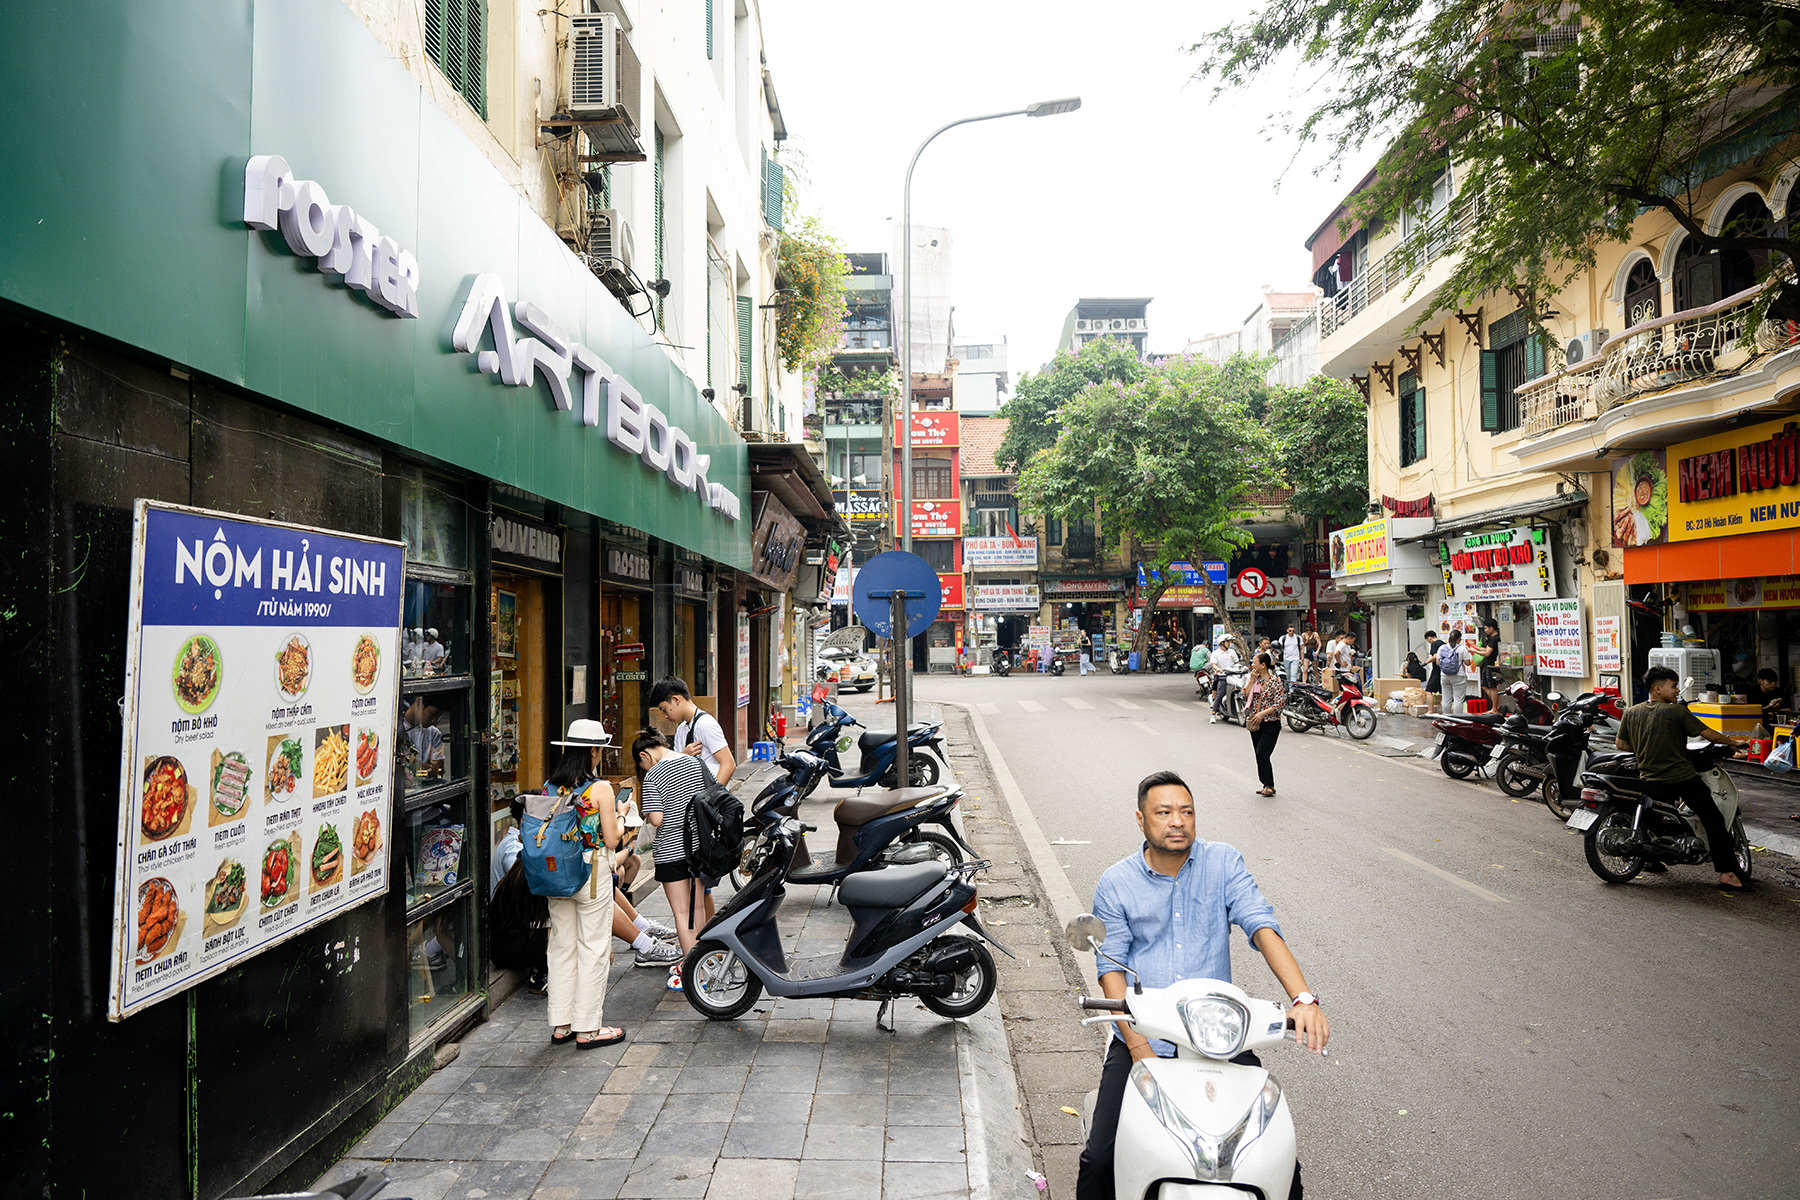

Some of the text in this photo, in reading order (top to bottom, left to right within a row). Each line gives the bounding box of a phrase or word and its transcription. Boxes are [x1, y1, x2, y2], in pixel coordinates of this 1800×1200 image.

[244, 155, 419, 319] POSTER
[453, 272, 711, 503] ARTBOOK
[1679, 422, 1800, 502] NEM NƯỚ
[1686, 514, 1742, 530] ĐC: 23 Hồ Hoàn Kiếm
[1750, 504, 1776, 522] NEM
[490, 516, 560, 563] OUVENIR
[966, 538, 1014, 549] PHỞ GÀ TA BÚN
[1464, 532, 1510, 548] LONG VI DUNG
[1346, 532, 1386, 567] NỘM THỊT BÒ KHÔ
[1452, 540, 1532, 574] NỘM THỊT BÒ KHÔ
[175, 527, 386, 600] NỘM HẢI SINH
[609, 550, 650, 580] POSTER
[1472, 568, 1512, 582] GIA TRUYỀN
[1689, 590, 1725, 608] THỊT NƯỚNG
[1764, 590, 1778, 602] NEM
[279, 599, 302, 616] NĂM
[1535, 603, 1551, 611] LONG
[1560, 602, 1577, 611] DUNG
[1536, 613, 1558, 628] Nộm
[1554, 627, 1566, 636] BỘT
[1568, 628, 1579, 637] LỌC
[1553, 637, 1559, 646] GÀ
[1560, 637, 1573, 646] CHIÊN
[1539, 656, 1565, 668] Nem
[272, 706, 285, 722] NỘM
[172, 714, 218, 735] NỘM BÒ KHÔ
[175, 730, 214, 744] Dry beef salad
[266, 814, 278, 826] NEM
[280, 810, 290, 822] RÁN
[215, 822, 245, 842] NEM CUỐN
[138, 837, 197, 864] CHÂN GÀ SỐT THÁI
[214, 842, 225, 851] Fresh
[226, 839, 239, 849] spring
[138, 851, 196, 874] Thai style chicken feet
[310, 894, 321, 906] NEM
[259, 912, 273, 928] CHIM
[204, 926, 245, 953] BÁNH BỘT LỌC
[200, 946, 229, 964] Tapioca meat
[135, 951, 188, 983] NEM CHUA RÁN
[131, 962, 191, 994] Fried fermented pork roll
